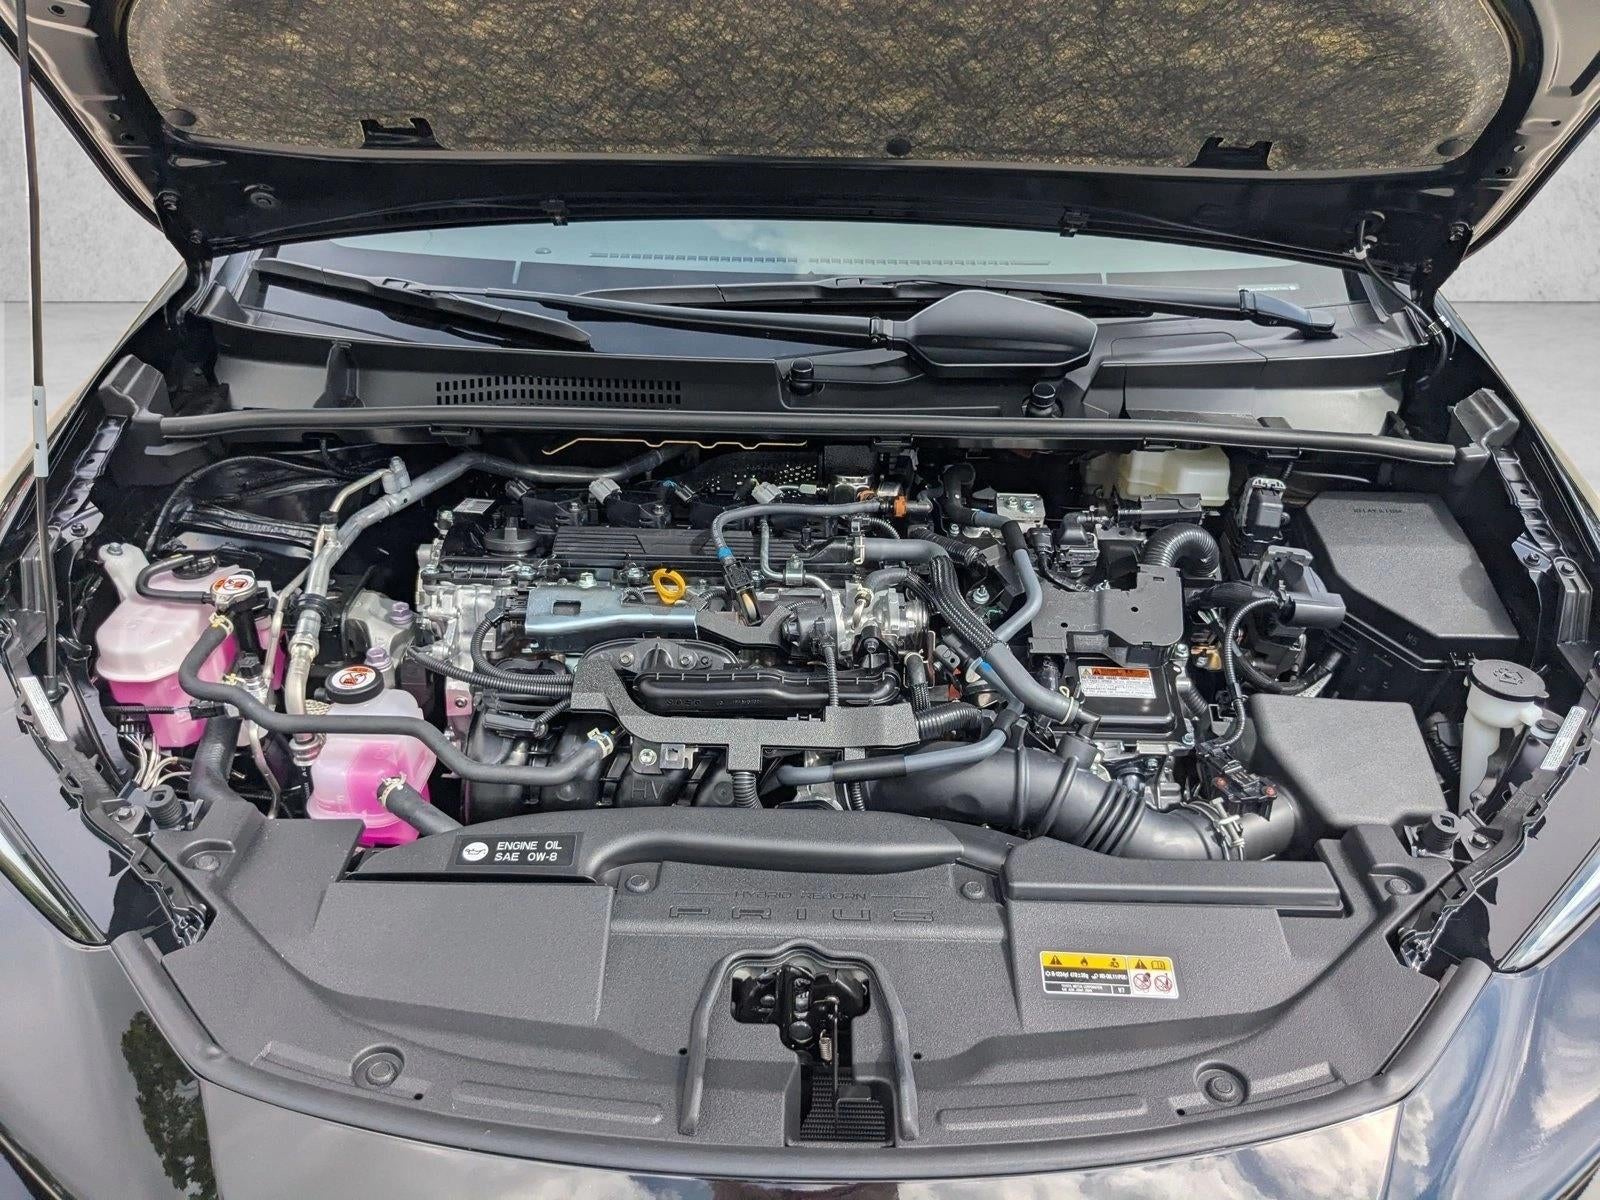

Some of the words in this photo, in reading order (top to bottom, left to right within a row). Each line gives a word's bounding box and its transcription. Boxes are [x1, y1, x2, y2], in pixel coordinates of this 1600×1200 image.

[631, 779, 664, 799] HV
[496, 841, 538, 850] ENGINE
[545, 840, 562, 850] OIL
[494, 852, 520, 861] SAE
[527, 852, 557, 861] 0W-8
[735, 891, 791, 899] HYBRID
[800, 891, 866, 900] REBORN
[669, 905, 934, 922] PRIUS
